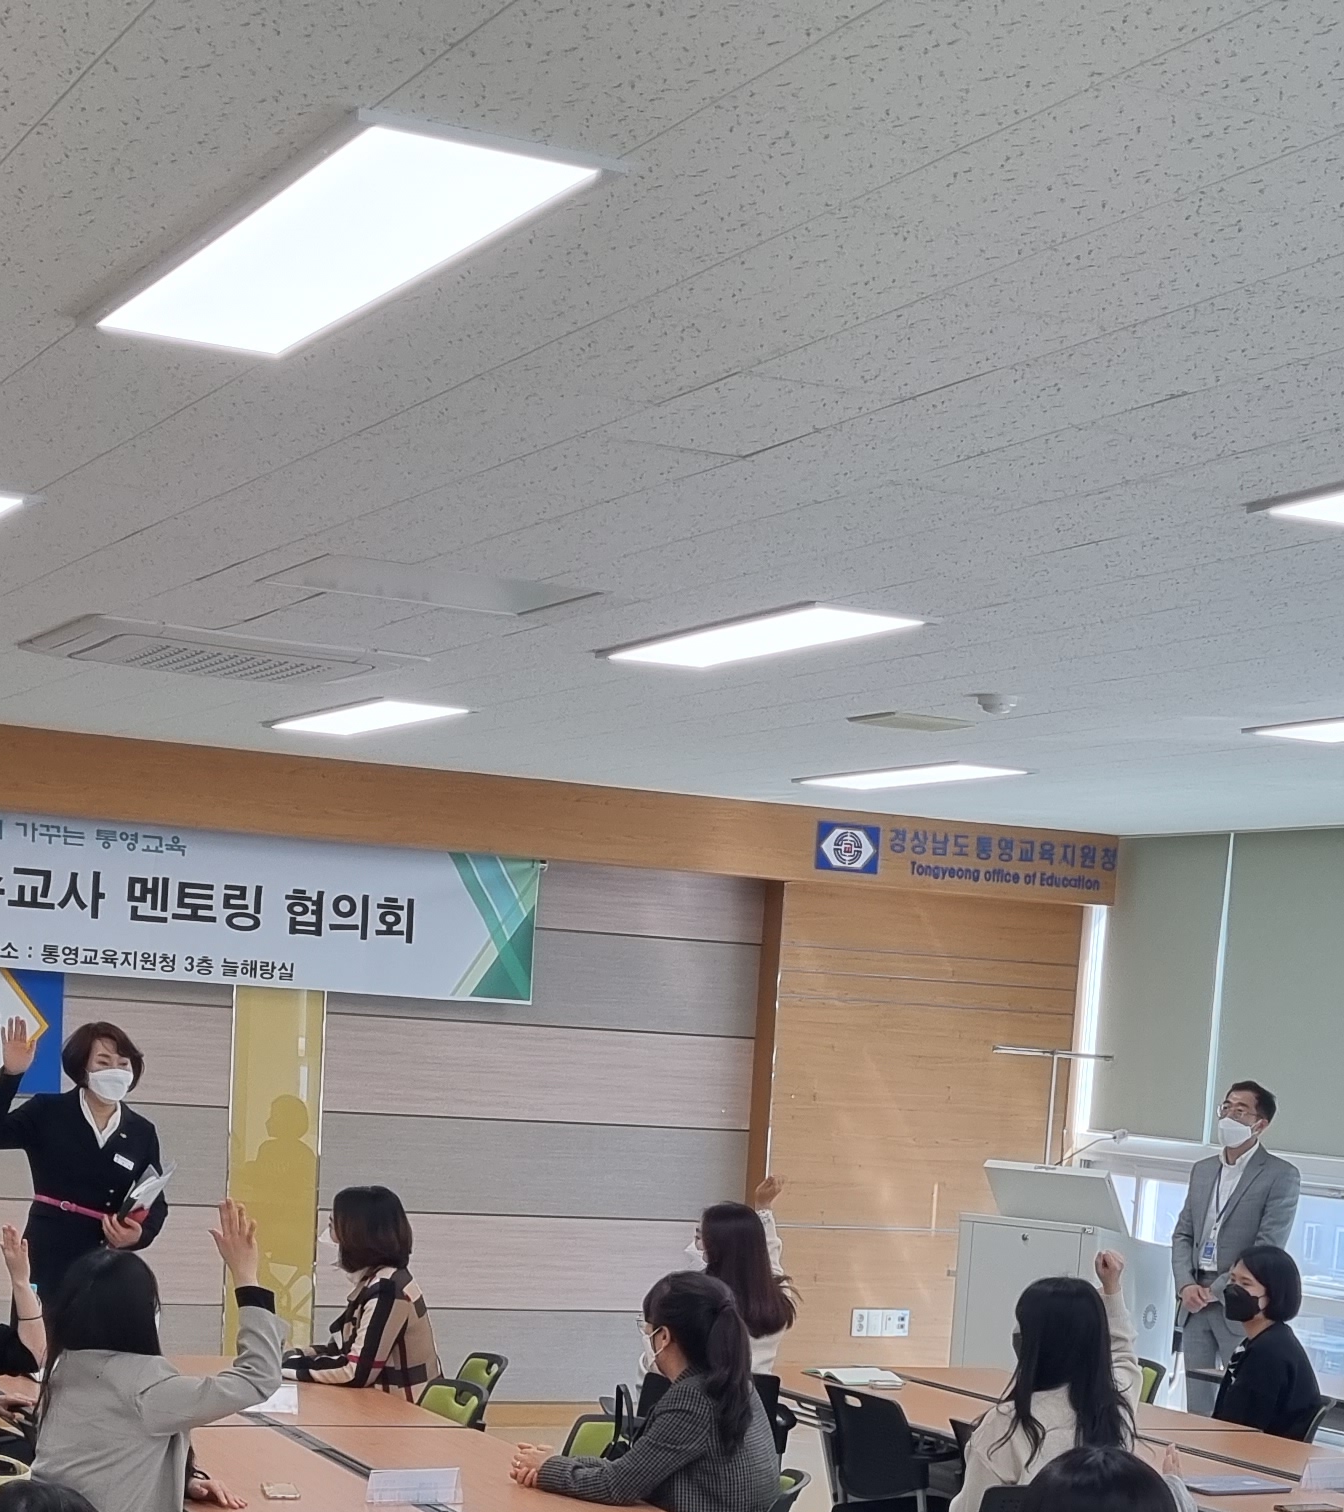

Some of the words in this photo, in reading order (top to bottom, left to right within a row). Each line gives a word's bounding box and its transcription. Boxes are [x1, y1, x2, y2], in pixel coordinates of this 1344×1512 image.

[14, 821, 86, 847] 가꾸는
[94, 828, 187, 858] 통영교육
[910, 860, 980, 883] Tongyeong
[985, 867, 1020, 884] office
[1024, 872, 1037, 886] of
[1040, 873, 1100, 891] Education
[126, 876, 264, 932] 멘토링
[284, 888, 415, 945] 협의회
[38, 943, 177, 975] 통영교육지원청
[183, 955, 215, 976] 3층
[220, 957, 295, 982] 늘해랑실
